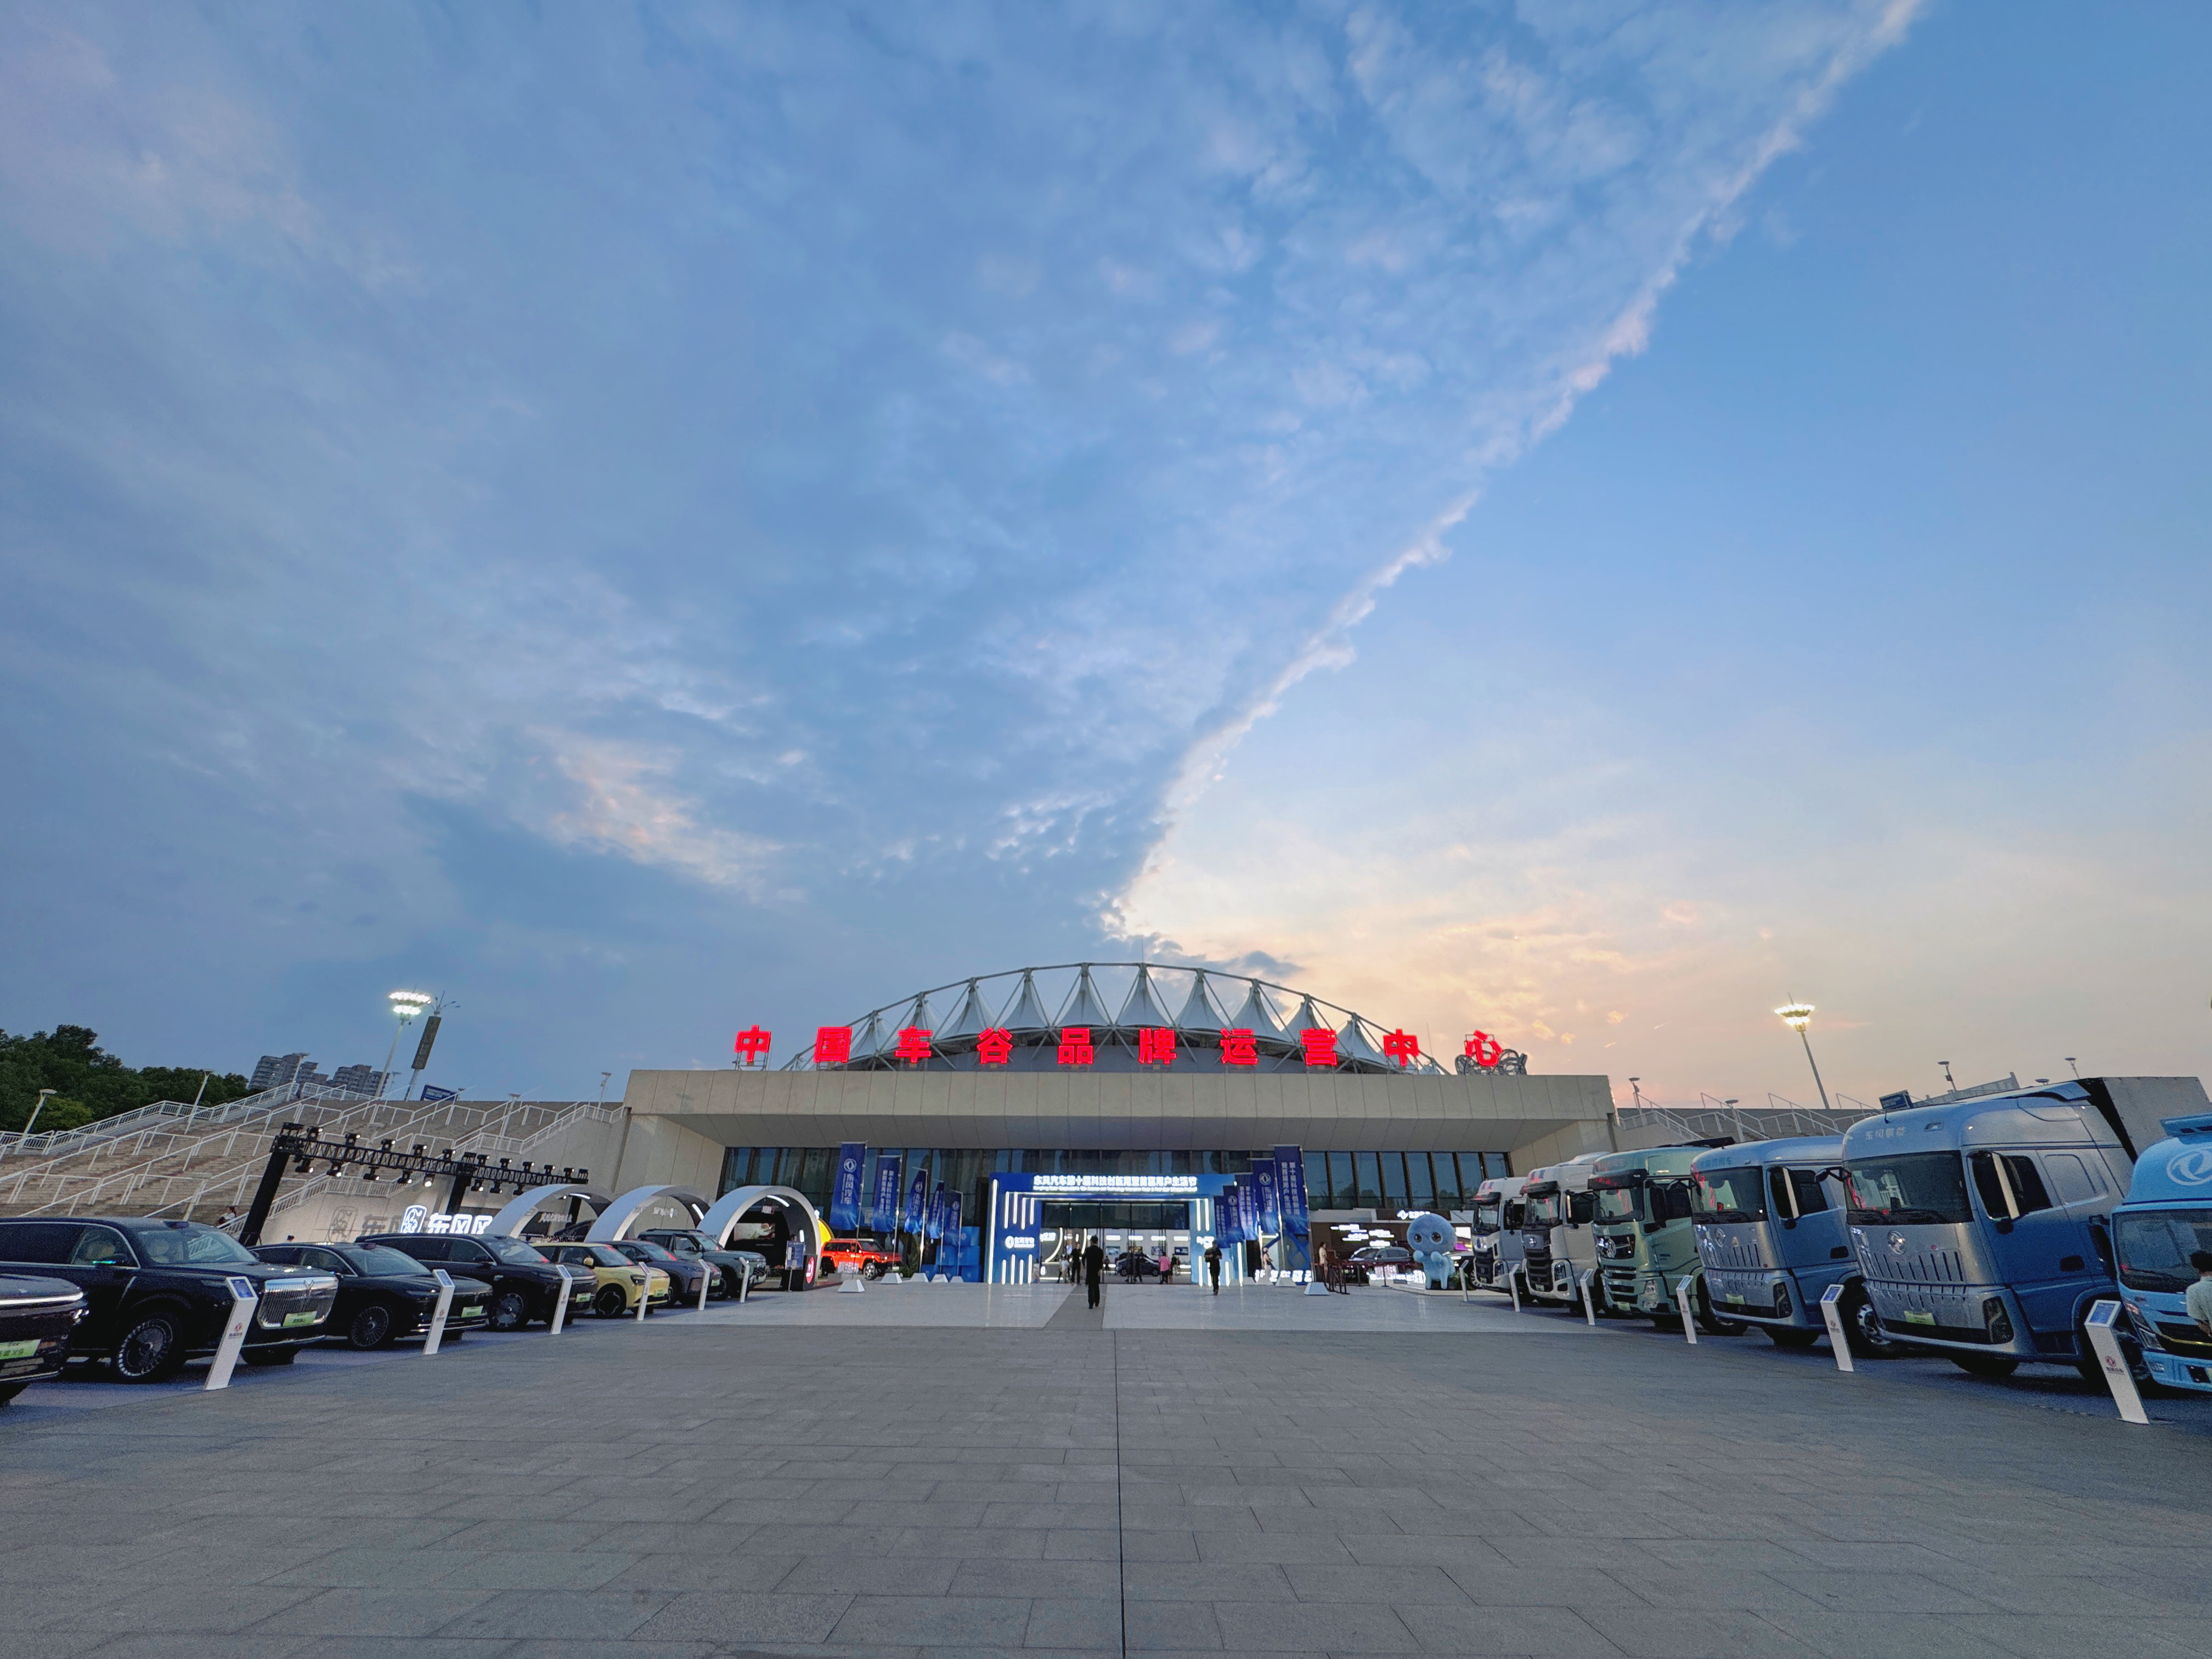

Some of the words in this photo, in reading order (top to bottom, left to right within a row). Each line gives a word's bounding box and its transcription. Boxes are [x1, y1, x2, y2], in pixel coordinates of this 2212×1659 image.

[735, 1024, 1503, 1067] 中国车谷品牌运营中心
